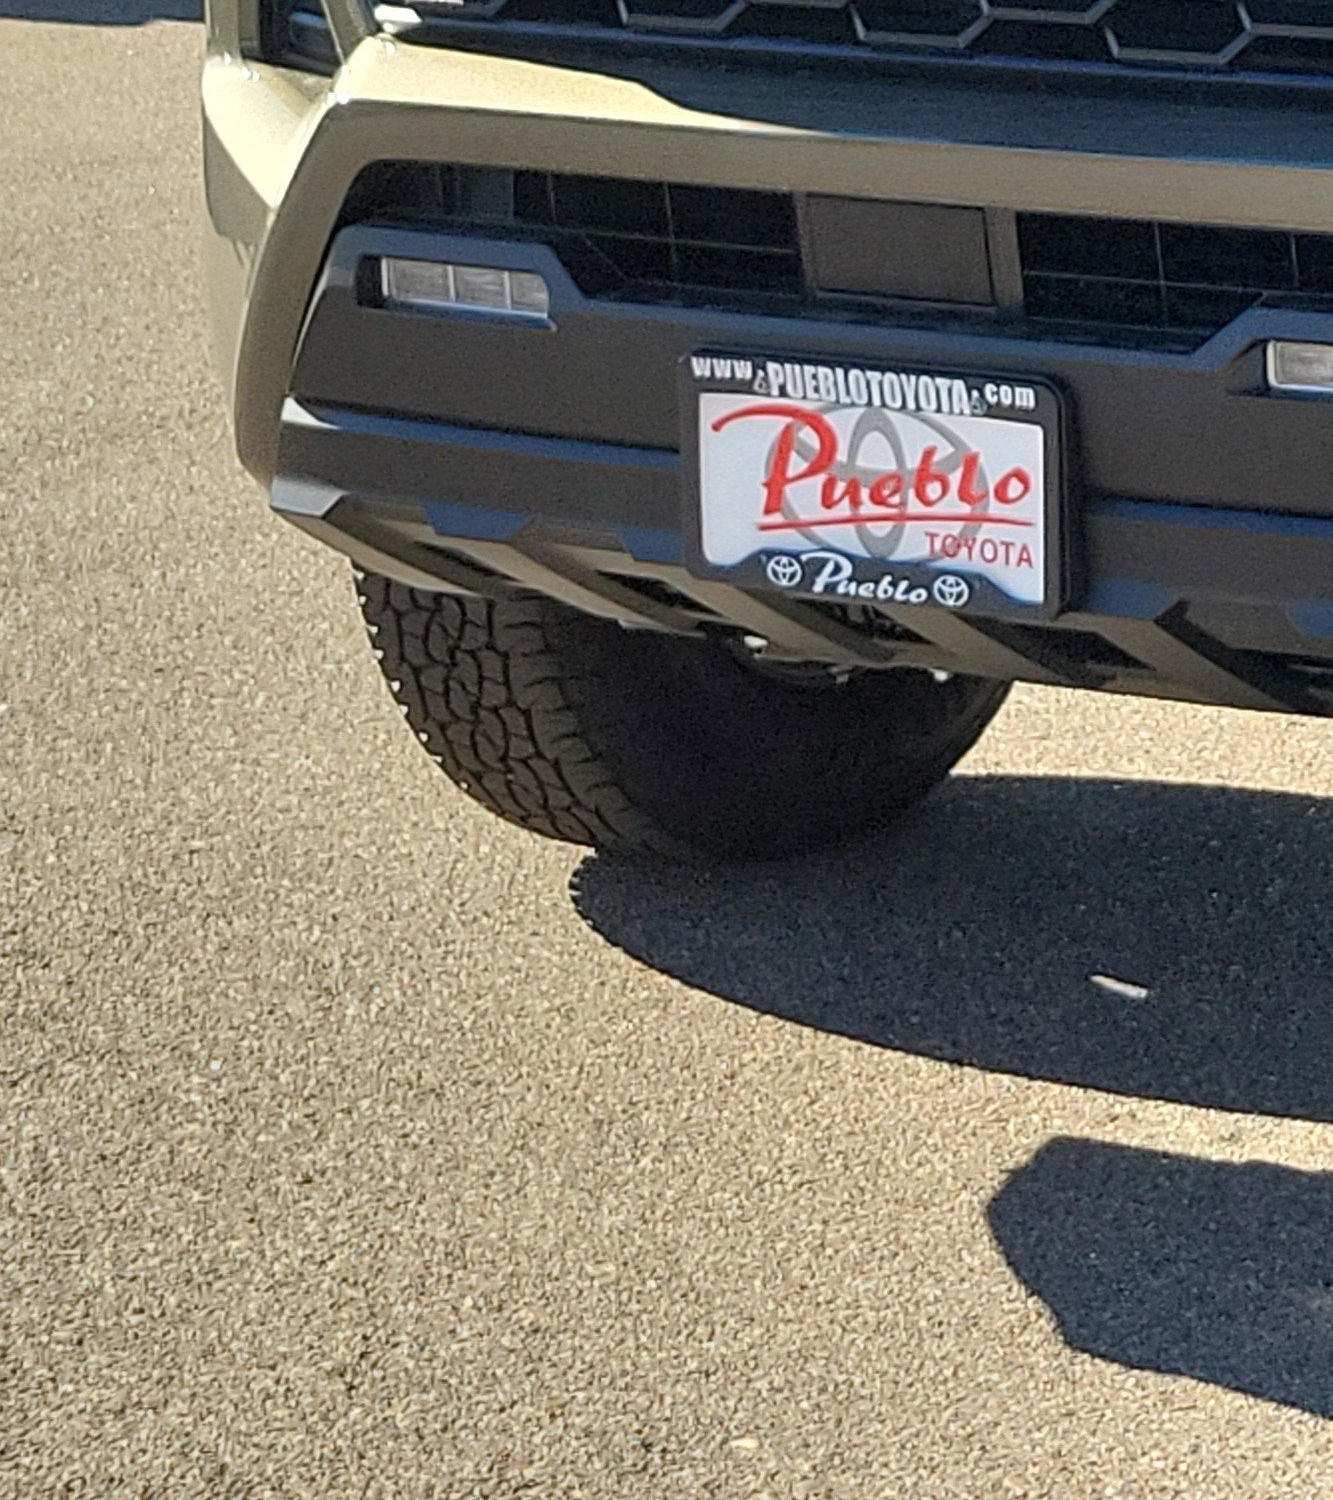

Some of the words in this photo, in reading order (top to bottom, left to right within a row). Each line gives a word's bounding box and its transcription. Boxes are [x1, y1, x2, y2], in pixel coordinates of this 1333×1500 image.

[711, 403, 1032, 516] Pueblo
[924, 531, 1034, 569] TOYOTA
[800, 551, 929, 605] Pueblo
